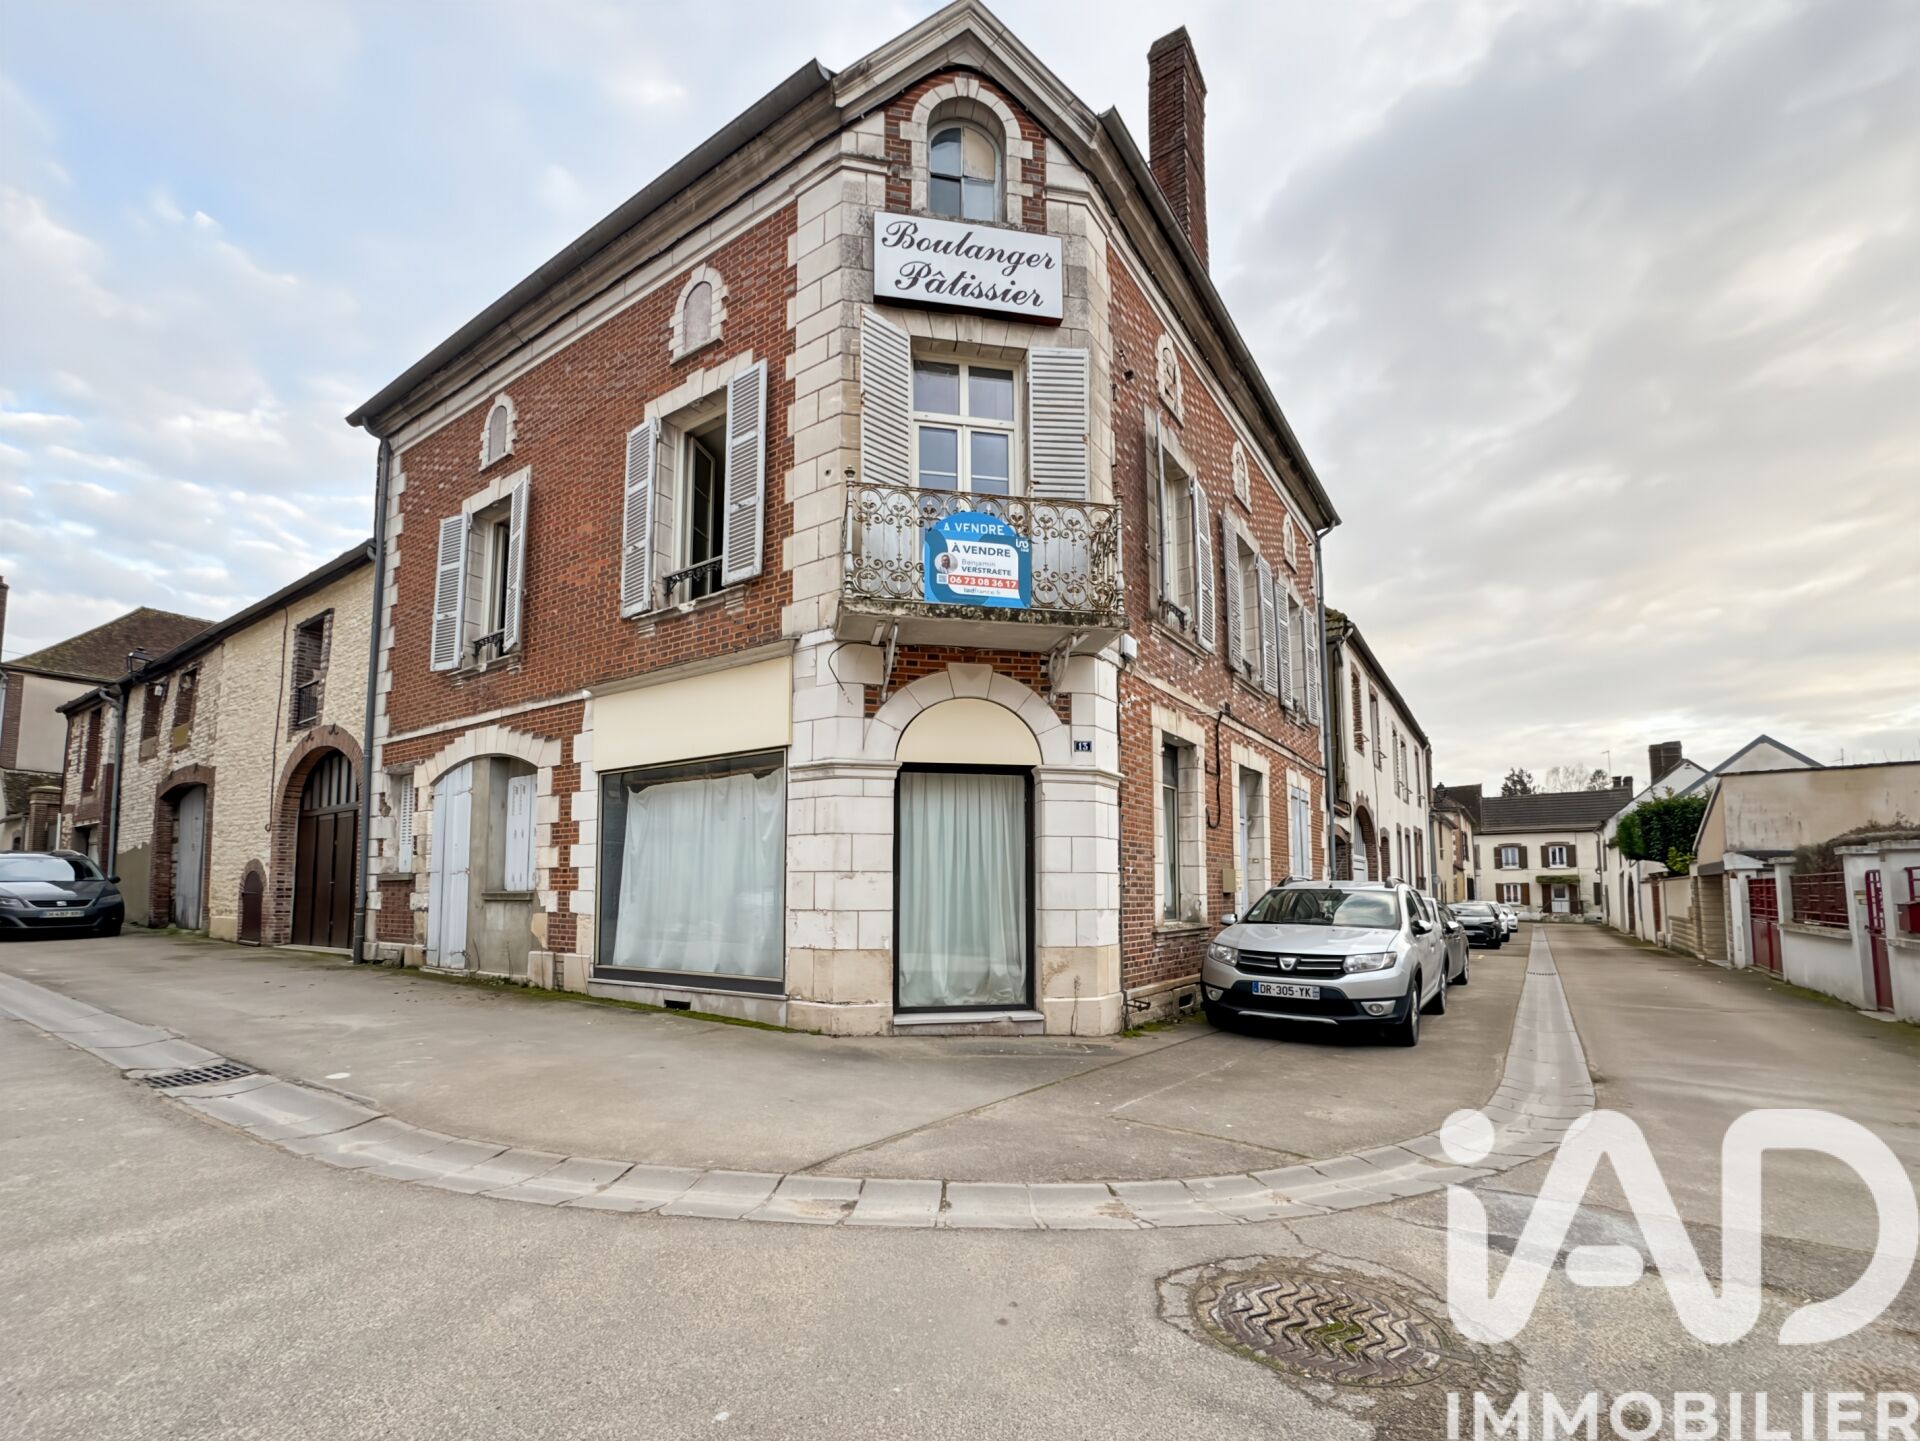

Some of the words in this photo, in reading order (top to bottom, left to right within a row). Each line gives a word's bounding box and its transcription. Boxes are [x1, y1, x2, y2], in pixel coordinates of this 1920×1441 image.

[882, 220, 1056, 277] Boulanger
[894, 260, 1044, 307] Pâtissier
[954, 523, 1005, 536] VENDRE
[951, 542, 961, 553] À
[962, 545, 1011, 558] VENDRE
[961, 566, 1012, 577] VERSTRAETE
[949, 575, 962, 584] 06
[963, 576, 977, 585] 73
[977, 578, 990, 586] 08
[991, 579, 1004, 587] 36
[1005, 580, 1017, 588] 17
[1260, 984, 1311, 998] DR-305-YK
